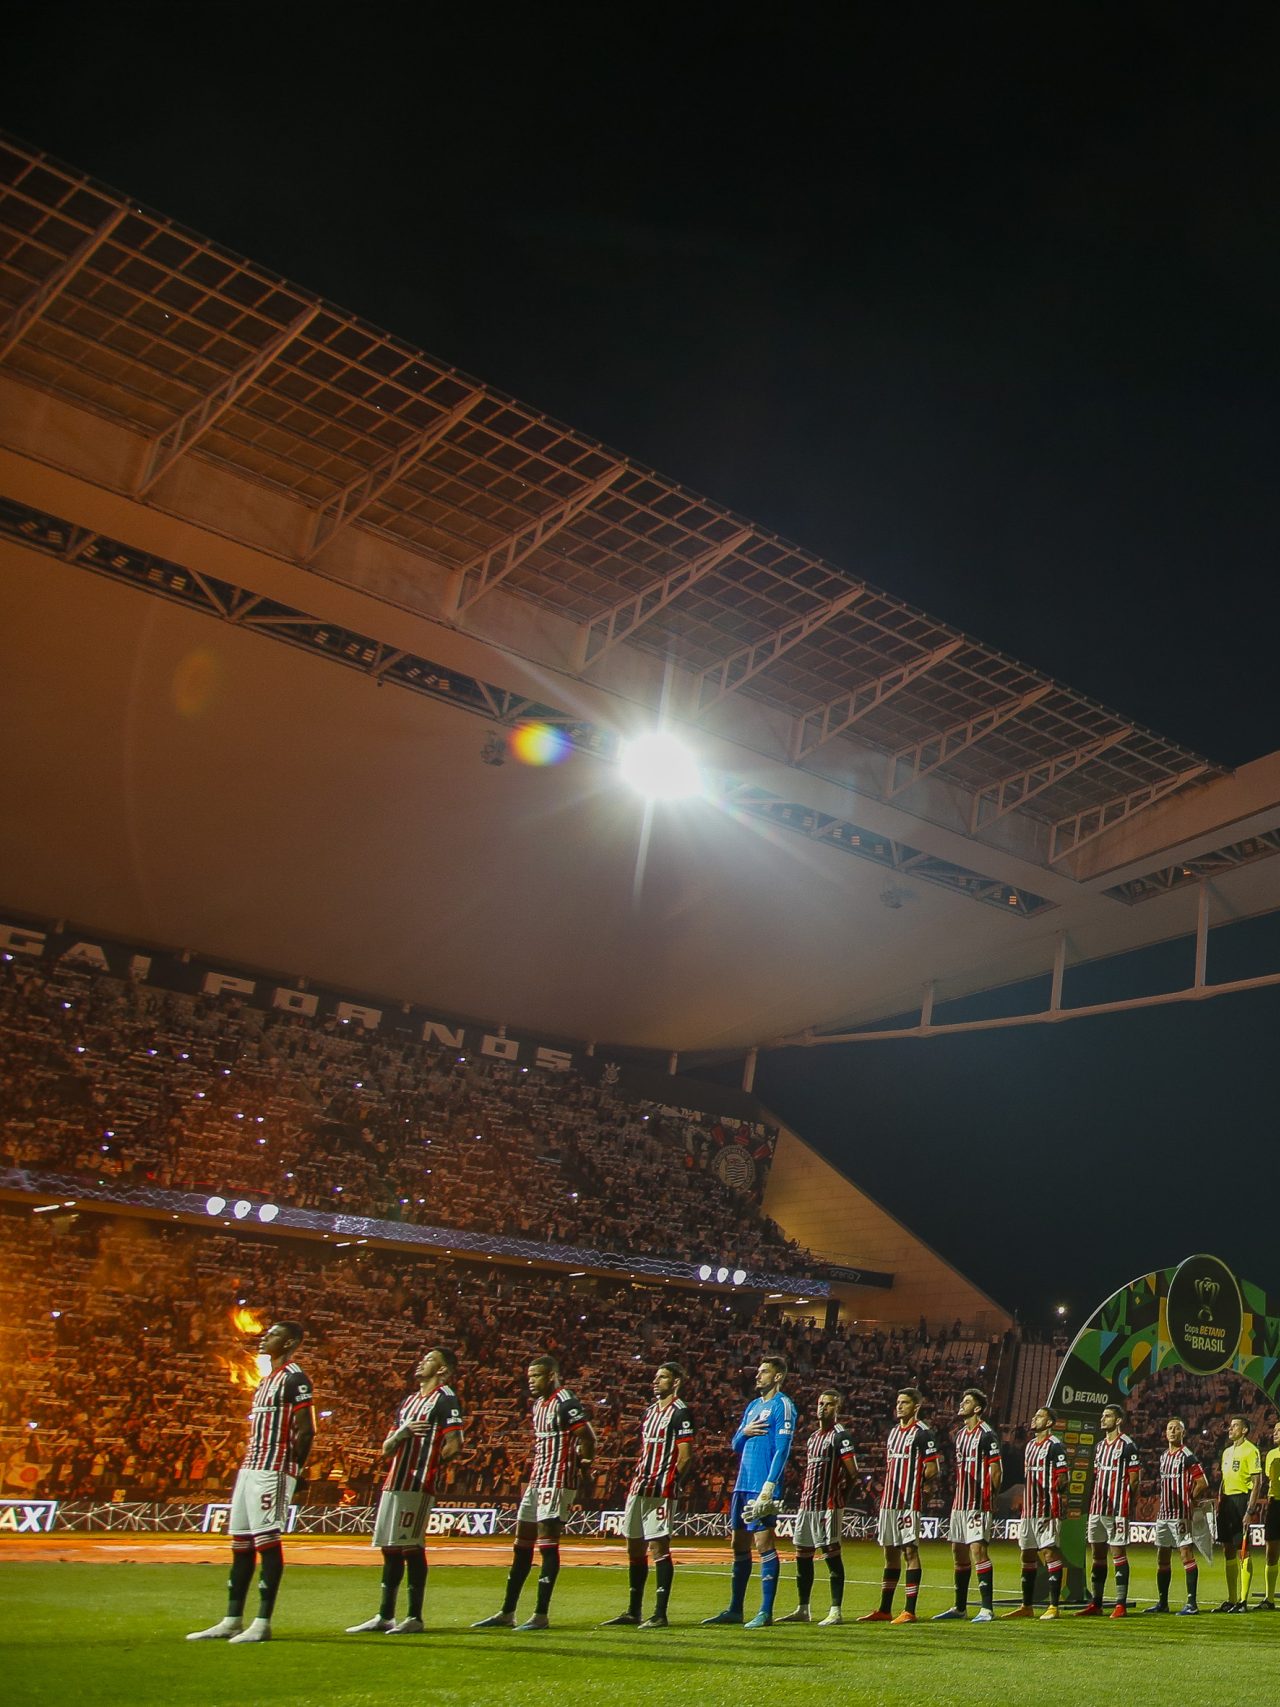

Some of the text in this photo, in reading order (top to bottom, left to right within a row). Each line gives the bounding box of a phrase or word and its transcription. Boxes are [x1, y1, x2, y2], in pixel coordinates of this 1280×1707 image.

[203, 971, 384, 1029] POR
[1184, 1323, 1226, 1337] Copa BETANO
[1184, 1334, 1226, 1354] do BRASIL
[1074, 1390, 1109, 1405] BETANO
[260, 1494, 272, 1510] 5
[426, 1514, 488, 1534] BRAX
[1130, 1526, 1157, 1544] BRA
